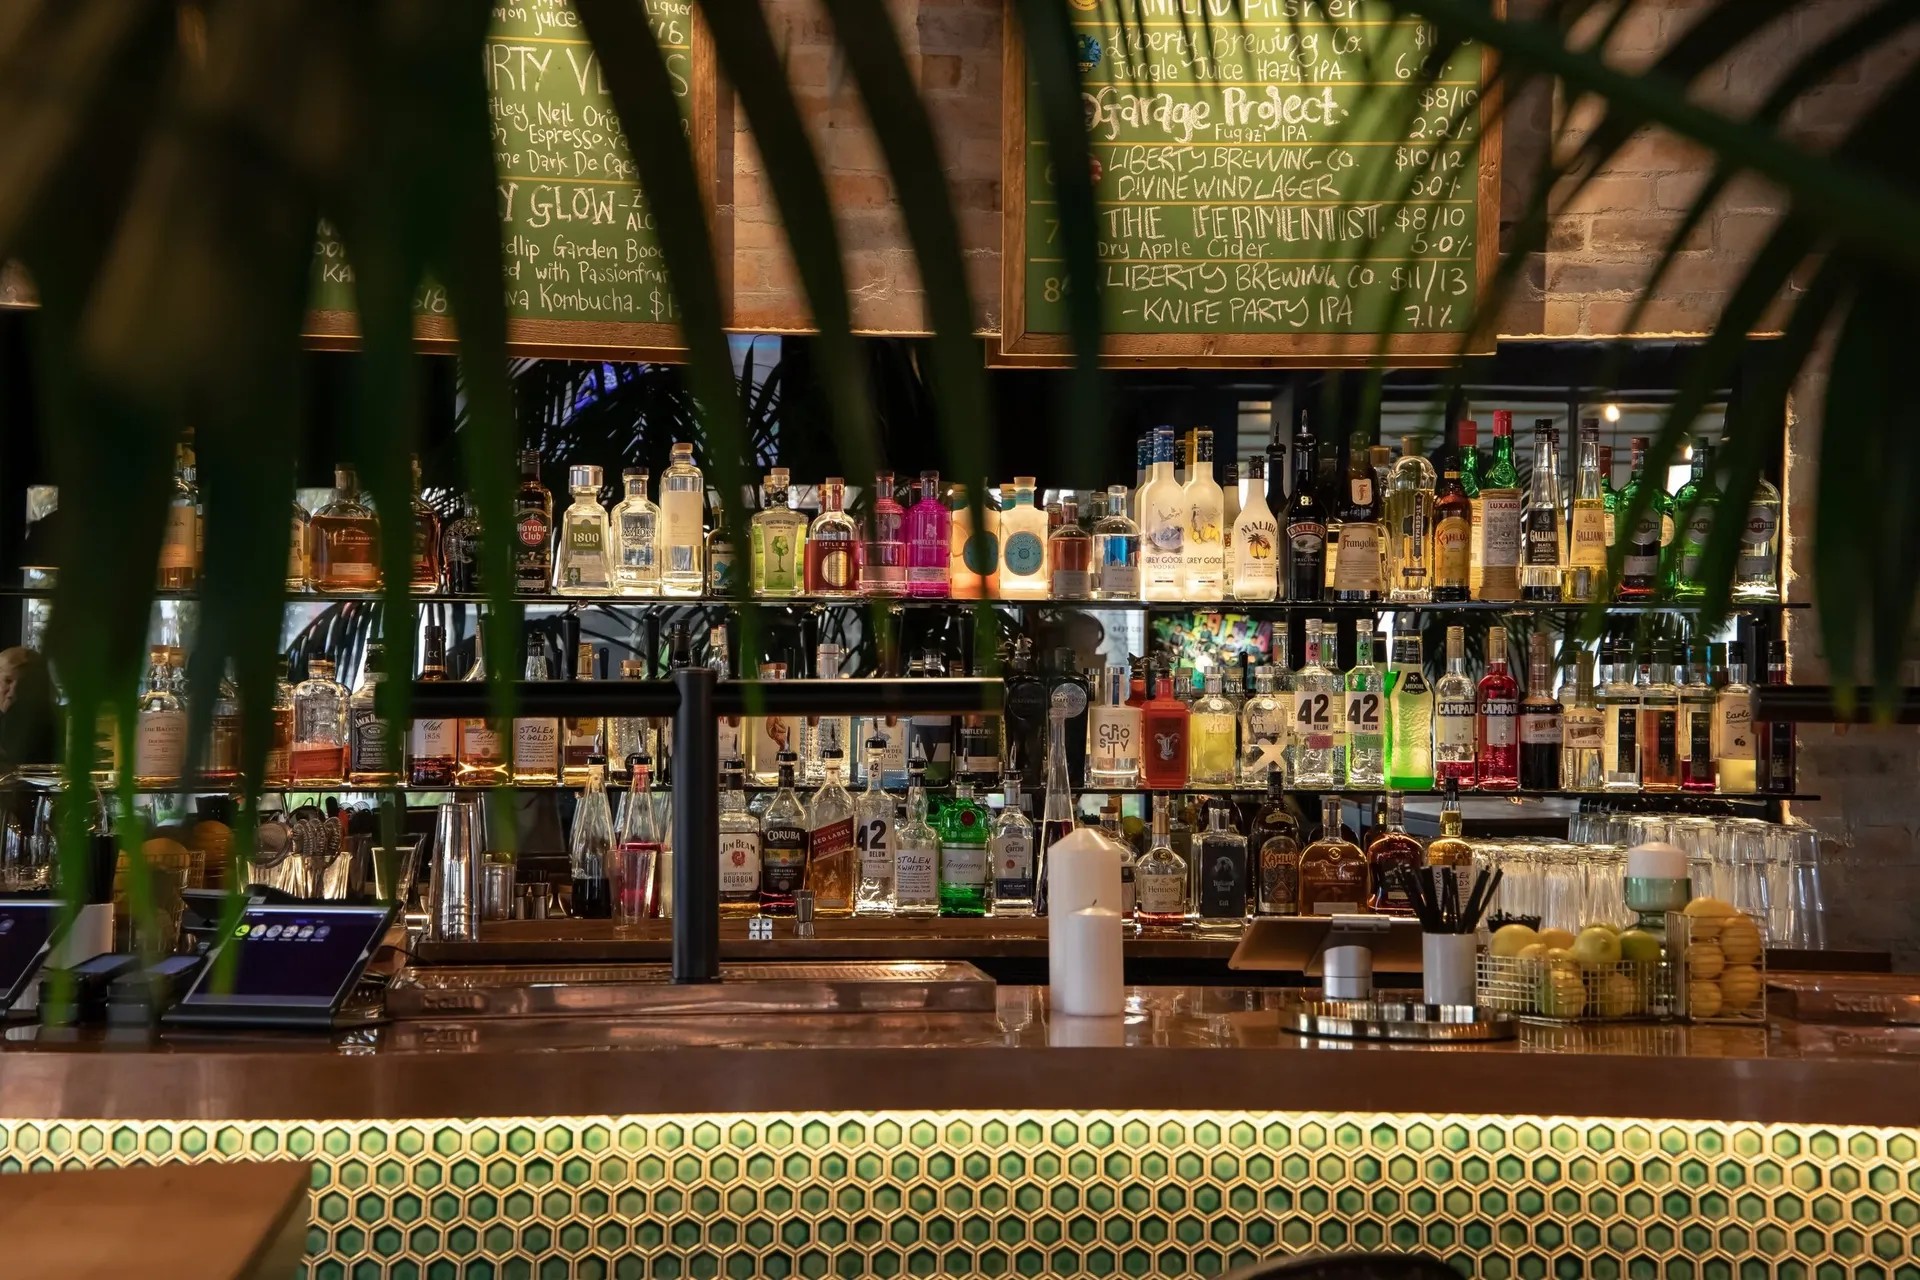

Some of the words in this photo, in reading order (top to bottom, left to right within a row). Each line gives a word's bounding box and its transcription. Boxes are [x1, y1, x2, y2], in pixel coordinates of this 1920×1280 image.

[1210, 26, 1318, 66] Brewing
[537, 101, 573, 127] Neil
[1215, 122, 1268, 144] Fugazi
[526, 149, 568, 175] Dark
[573, 150, 598, 177] De
[1108, 145, 1208, 175] LIBERTY
[1210, 146, 1322, 174] BREWING
[1193, 175, 1251, 201] WIND
[1253, 173, 1342, 202] LAGER
[526, 184, 616, 228] GLOW
[1395, 205, 1466, 233] $8/10
[1102, 205, 1166, 240] THE
[552, 234, 618, 260] Garden
[1138, 238, 1194, 261] Apple
[535, 263, 570, 282] with
[1106, 261, 1228, 295] LIBERTY
[1234, 262, 1341, 292] BREWING
[1229, 296, 1310, 328] PARTY
[1319, 294, 1353, 327] IPA
[517, 522, 548, 534] Havana
[522, 532, 542, 542] Club
[573, 532, 600, 544] 1800
[1297, 693, 1329, 725] 42
[1347, 693, 1379, 725] 42
[519, 725, 555, 734] STOLEN
[767, 830, 800, 841] CORUBA
[857, 819, 887, 852] 42
[896, 855, 931, 865] STOLEN
[723, 875, 753, 883] BOURBON
